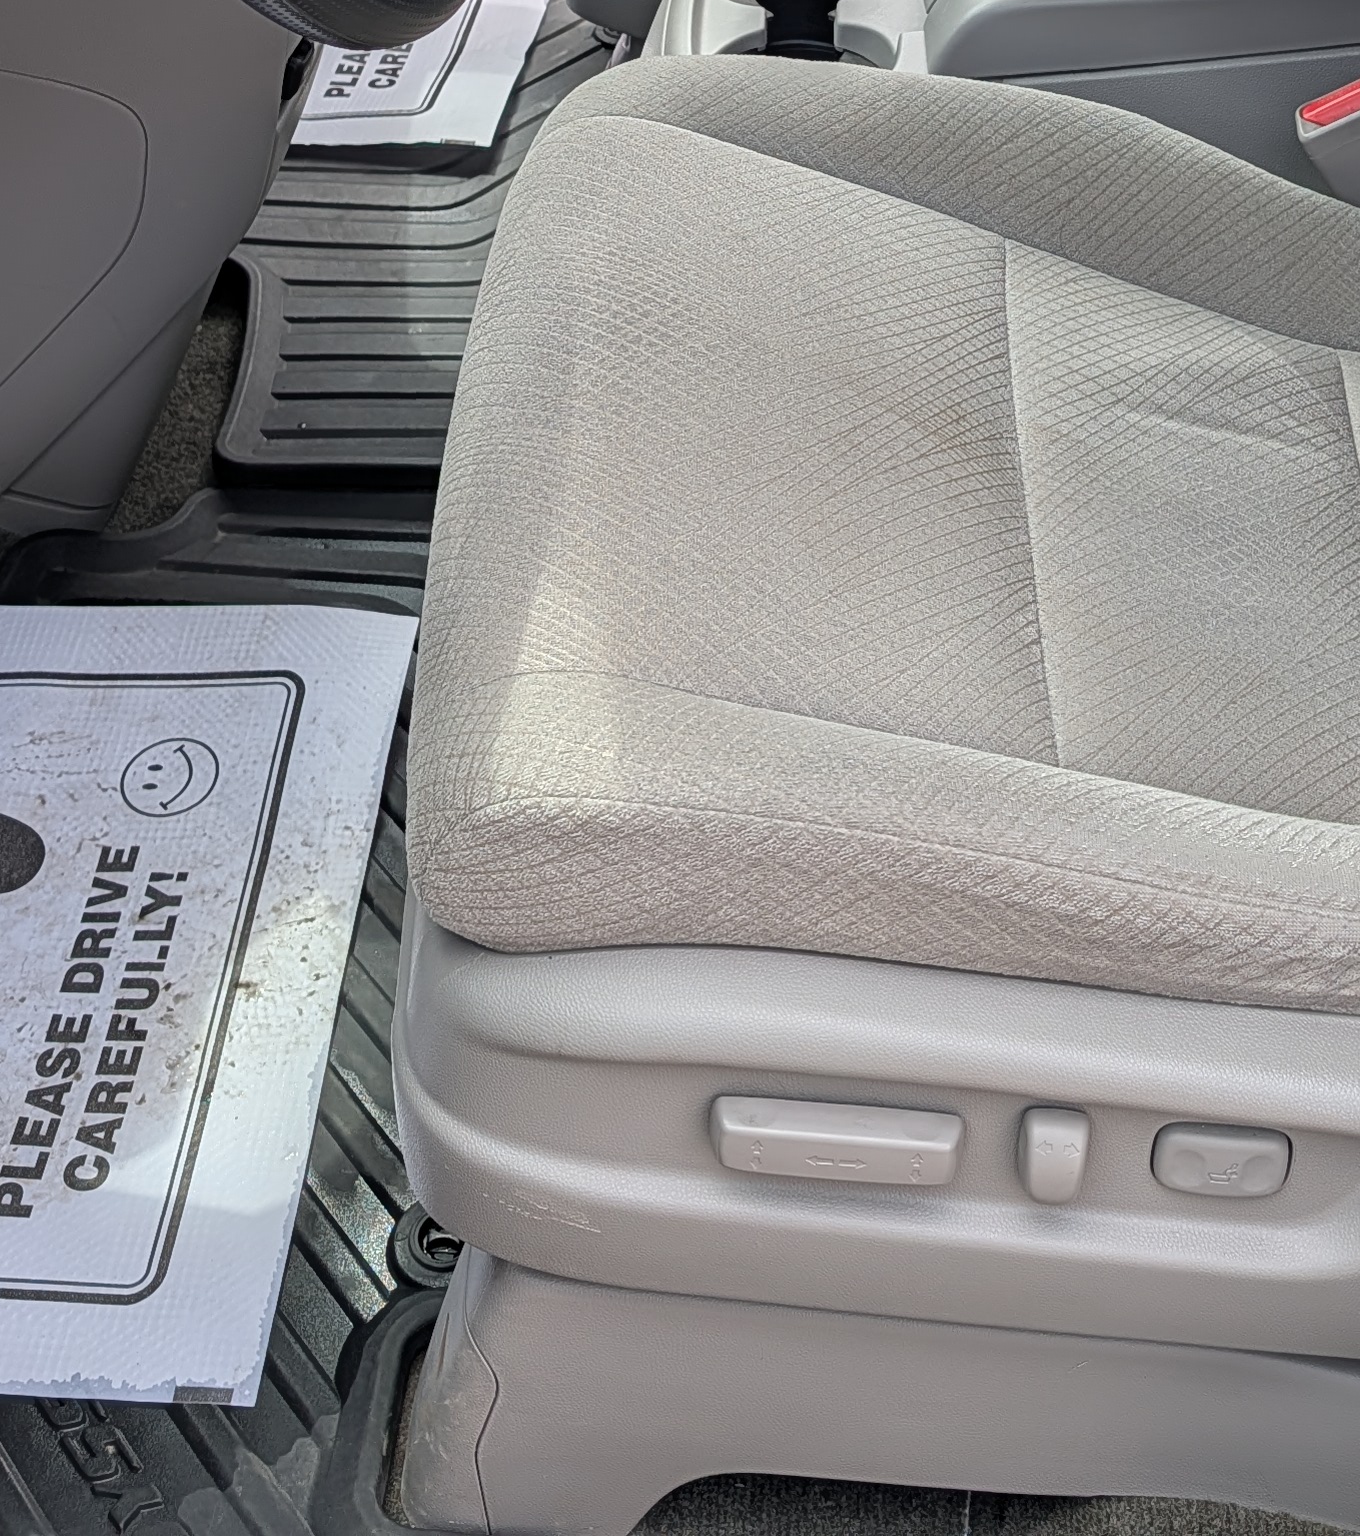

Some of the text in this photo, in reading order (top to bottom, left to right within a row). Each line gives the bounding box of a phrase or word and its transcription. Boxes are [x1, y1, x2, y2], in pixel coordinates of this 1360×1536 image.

[323, 51, 371, 98] PLEA
[59, 845, 141, 994] DRIVE
[63, 871, 189, 1192] CAREFULLY!
